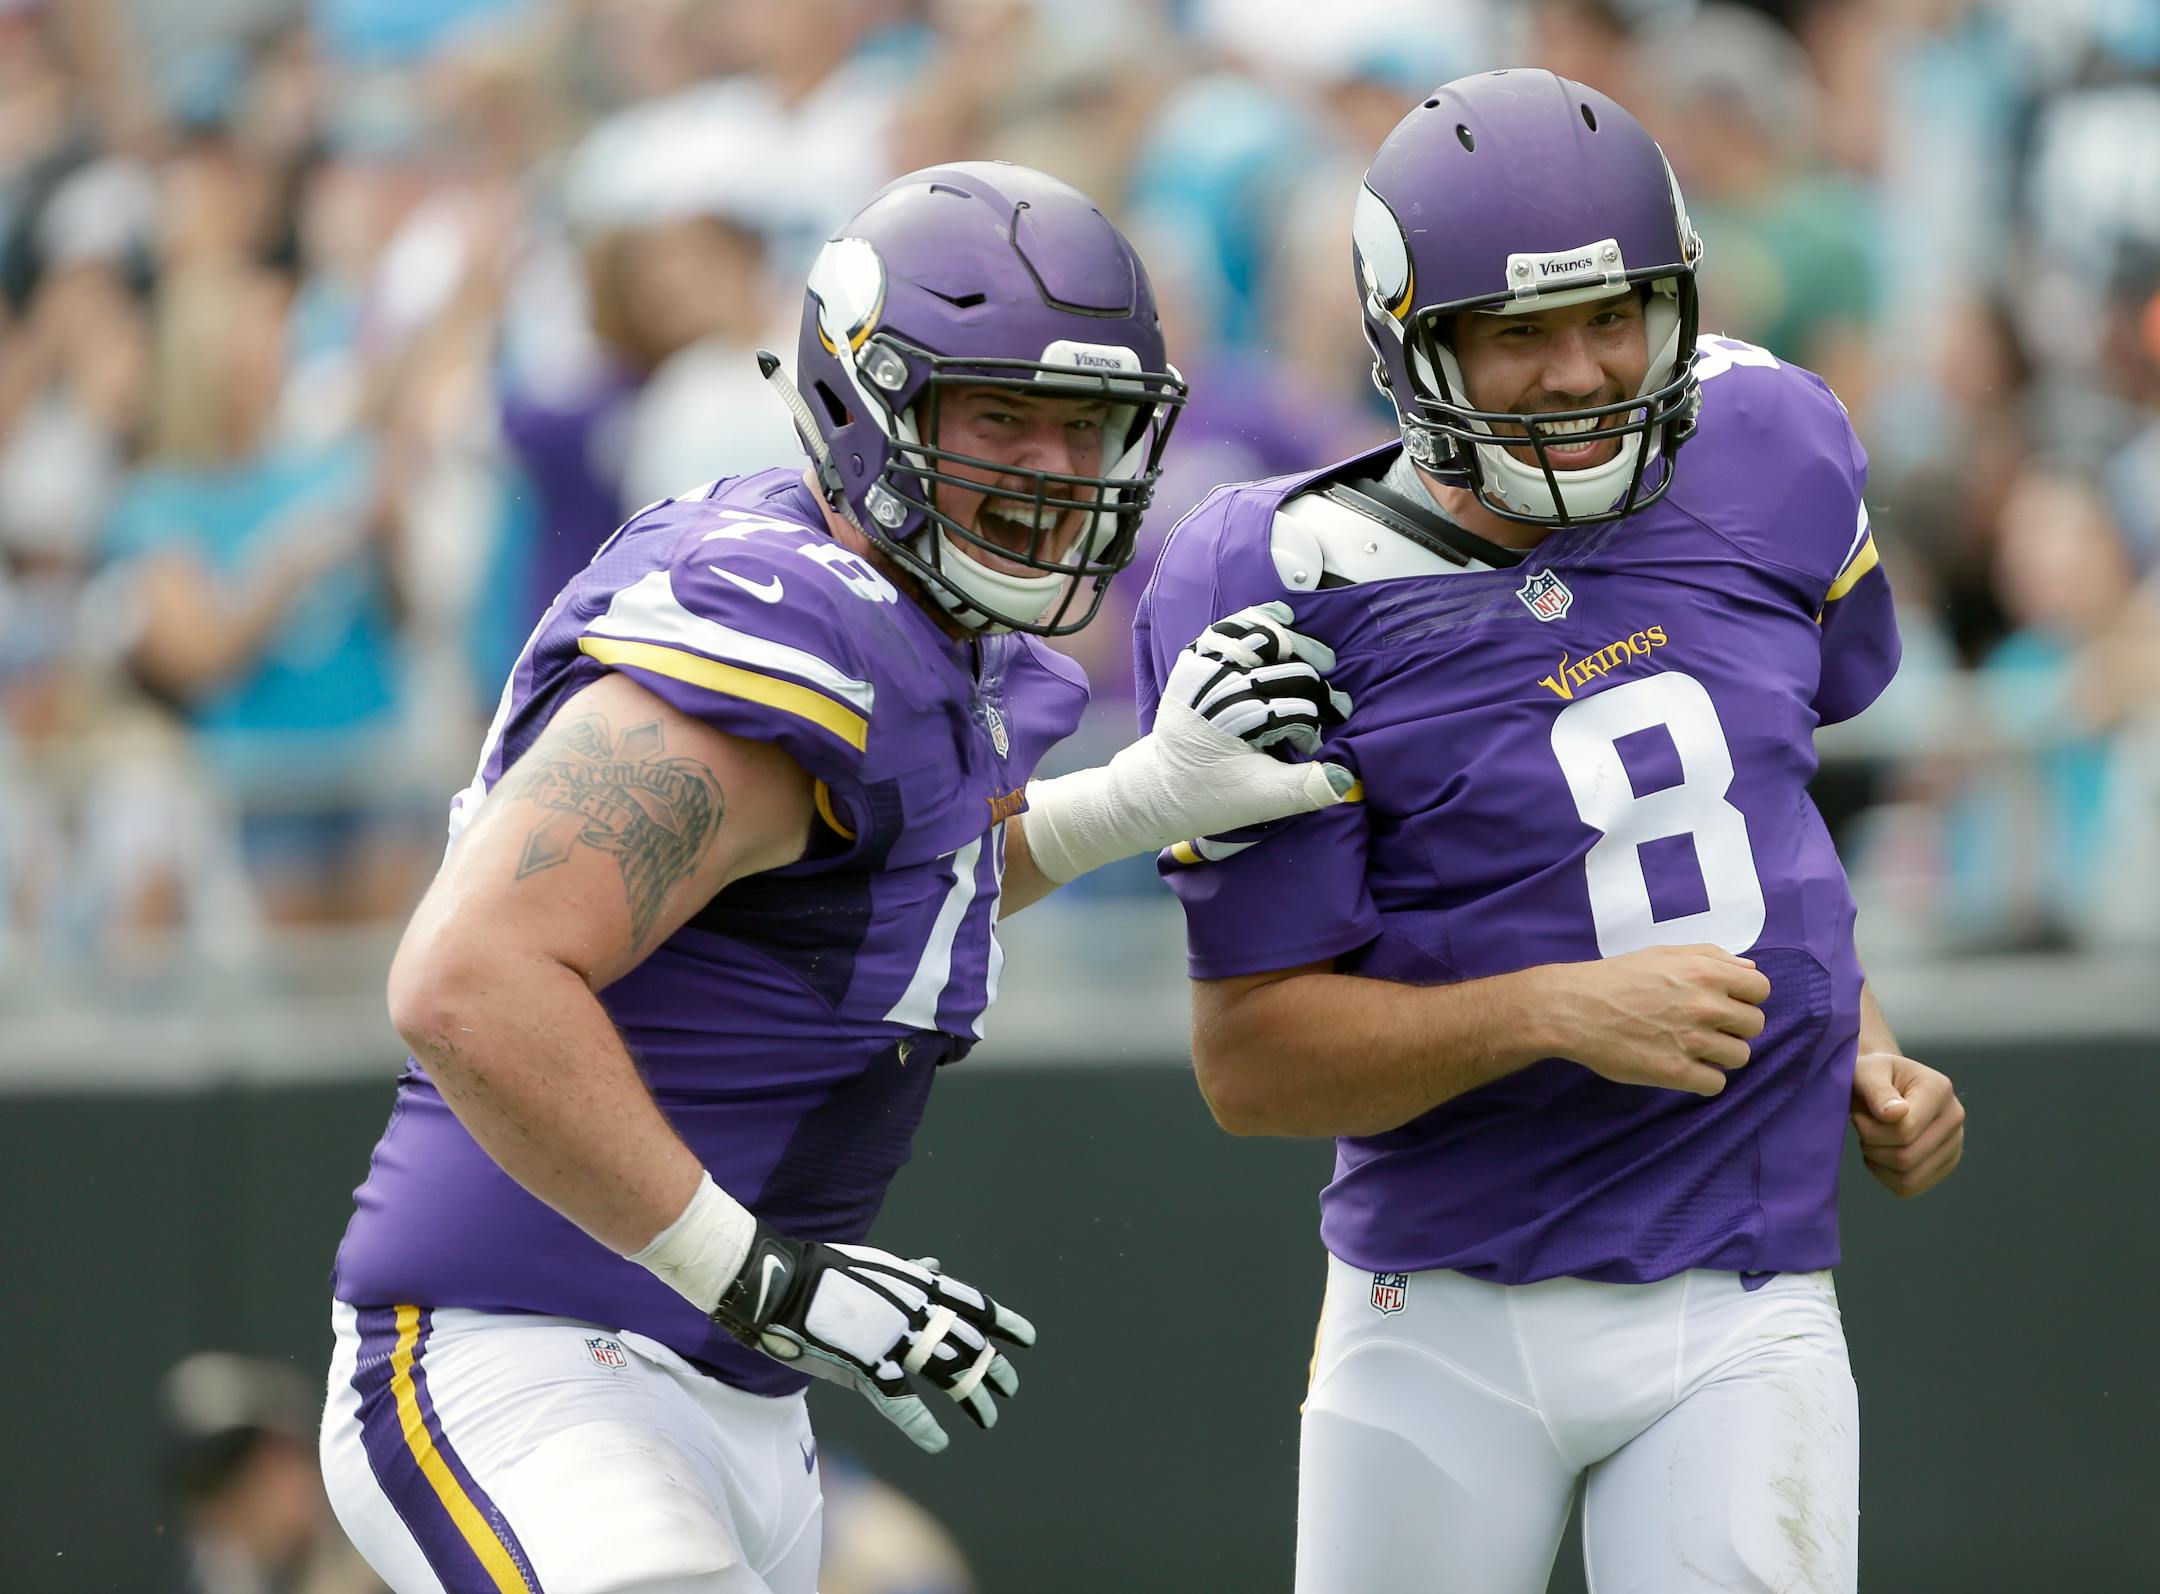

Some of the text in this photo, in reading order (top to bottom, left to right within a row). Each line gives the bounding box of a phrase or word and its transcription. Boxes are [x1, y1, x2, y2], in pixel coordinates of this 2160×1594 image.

[1539, 257, 1593, 276] VIKINGS
[1534, 588, 1567, 616] NFL
[1538, 625, 1668, 699] VIKINGS
[1550, 671, 1767, 959] 8
[1374, 1286, 1401, 1310] NFL
[593, 1349, 624, 1366] NFL
